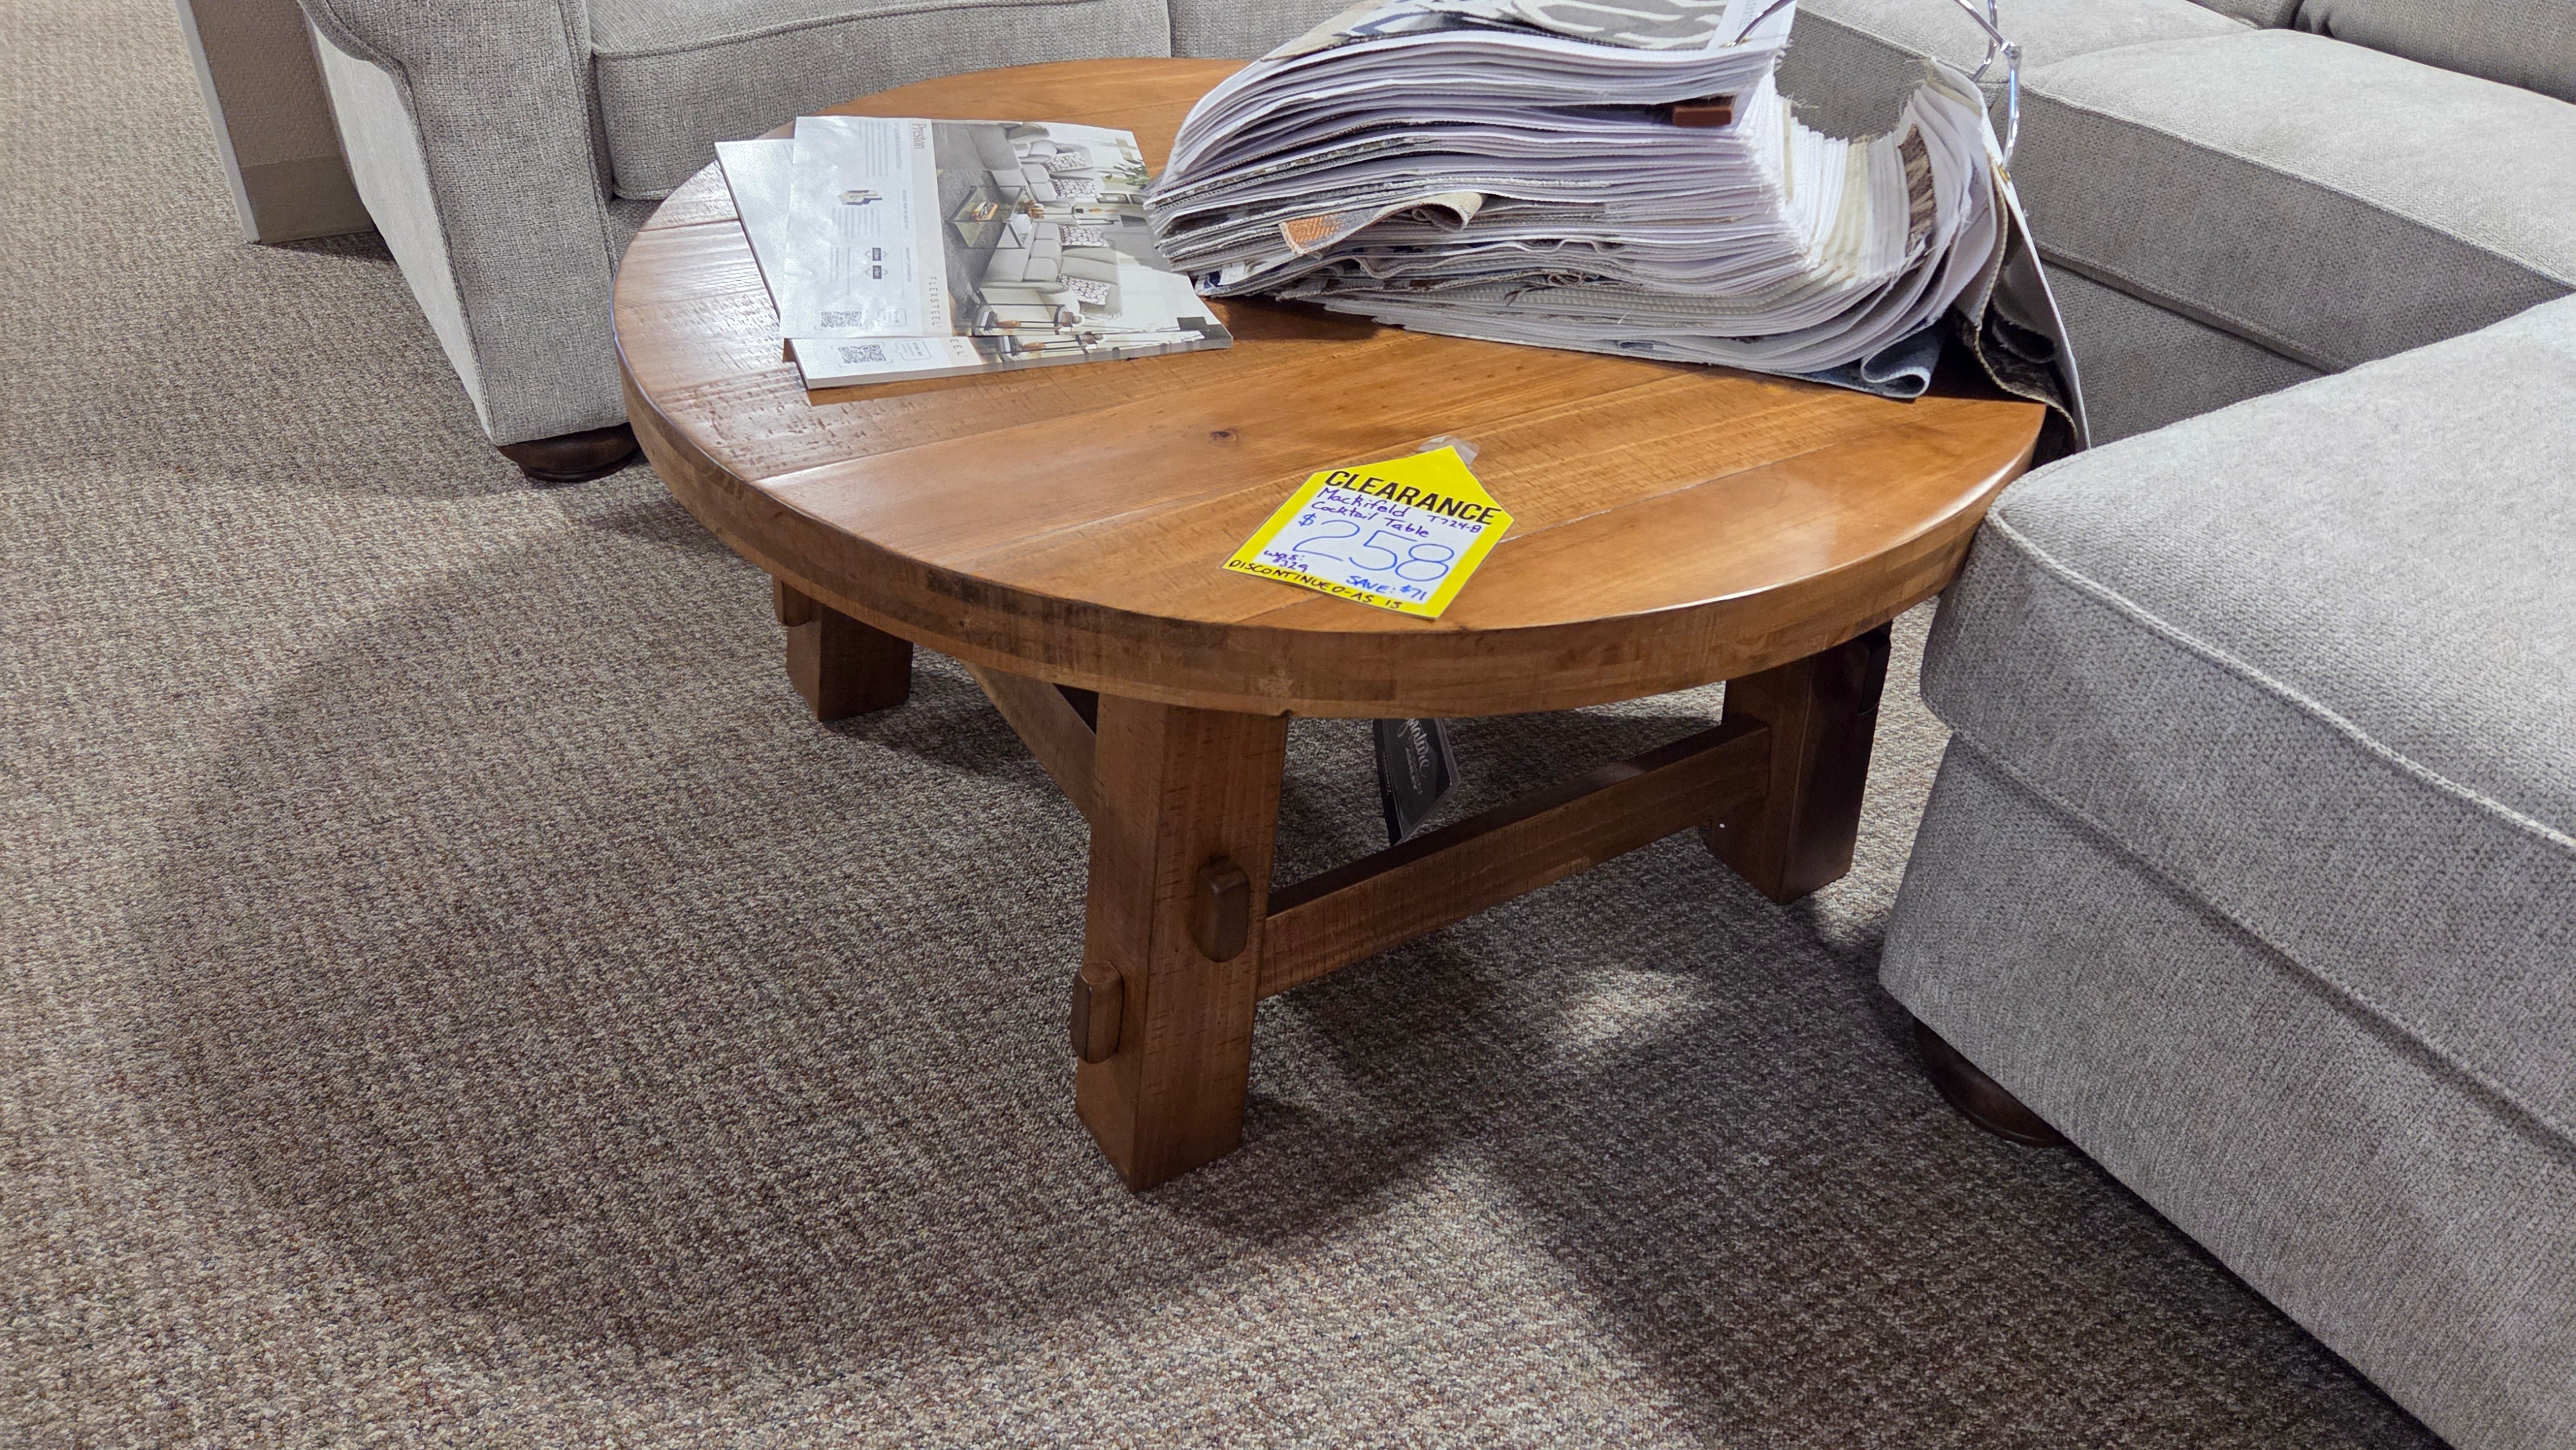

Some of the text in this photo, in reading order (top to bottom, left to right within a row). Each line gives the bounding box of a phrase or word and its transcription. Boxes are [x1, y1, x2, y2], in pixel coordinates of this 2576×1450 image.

[911, 123, 927, 149] Preston
[928, 276, 941, 326] FLEXSTEEL
[1325, 471, 1502, 525] CLEARANCE
[1311, 501, 1430, 538] Cocktail Table
[1426, 514, 1482, 534] T724-8
[1385, 599, 1403, 609] IS
